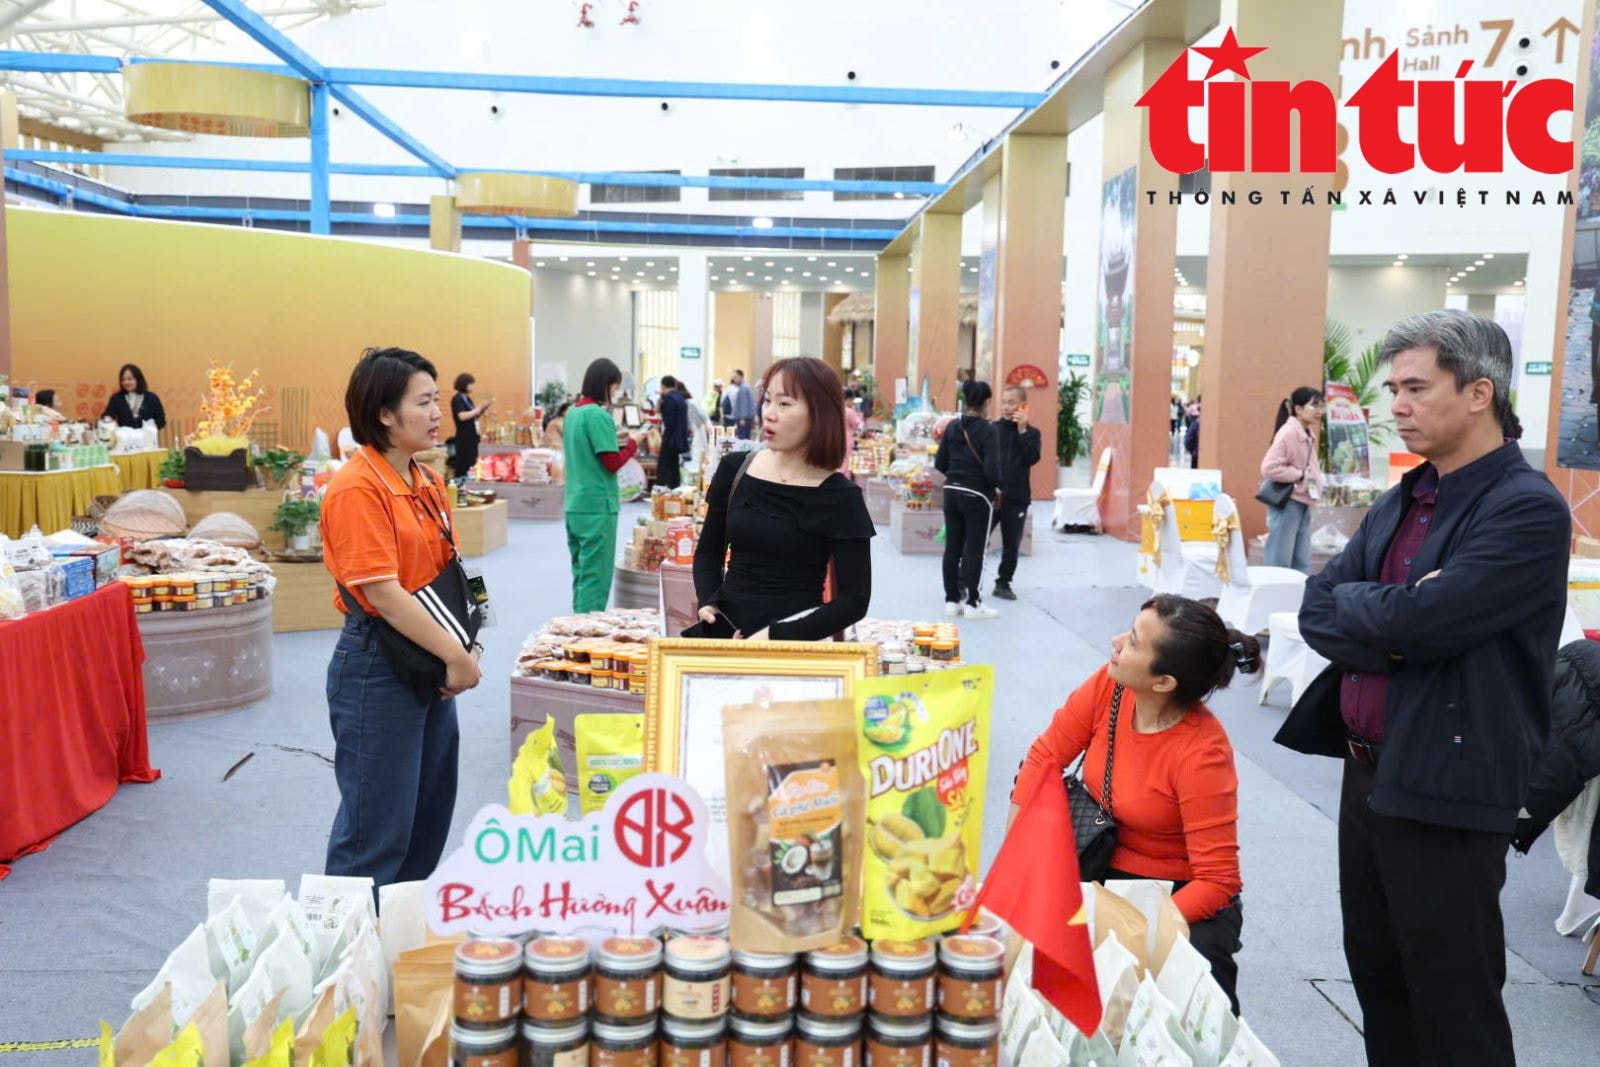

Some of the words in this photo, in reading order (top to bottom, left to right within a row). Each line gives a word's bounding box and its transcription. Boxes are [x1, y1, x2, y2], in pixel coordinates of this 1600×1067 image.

[1402, 55, 1441, 72] Hall
[1405, 24, 1470, 48] Sảnh
[1480, 19, 1515, 68] 7
[869, 719, 979, 800] DURIONE
[645, 879, 731, 918] Xuân
